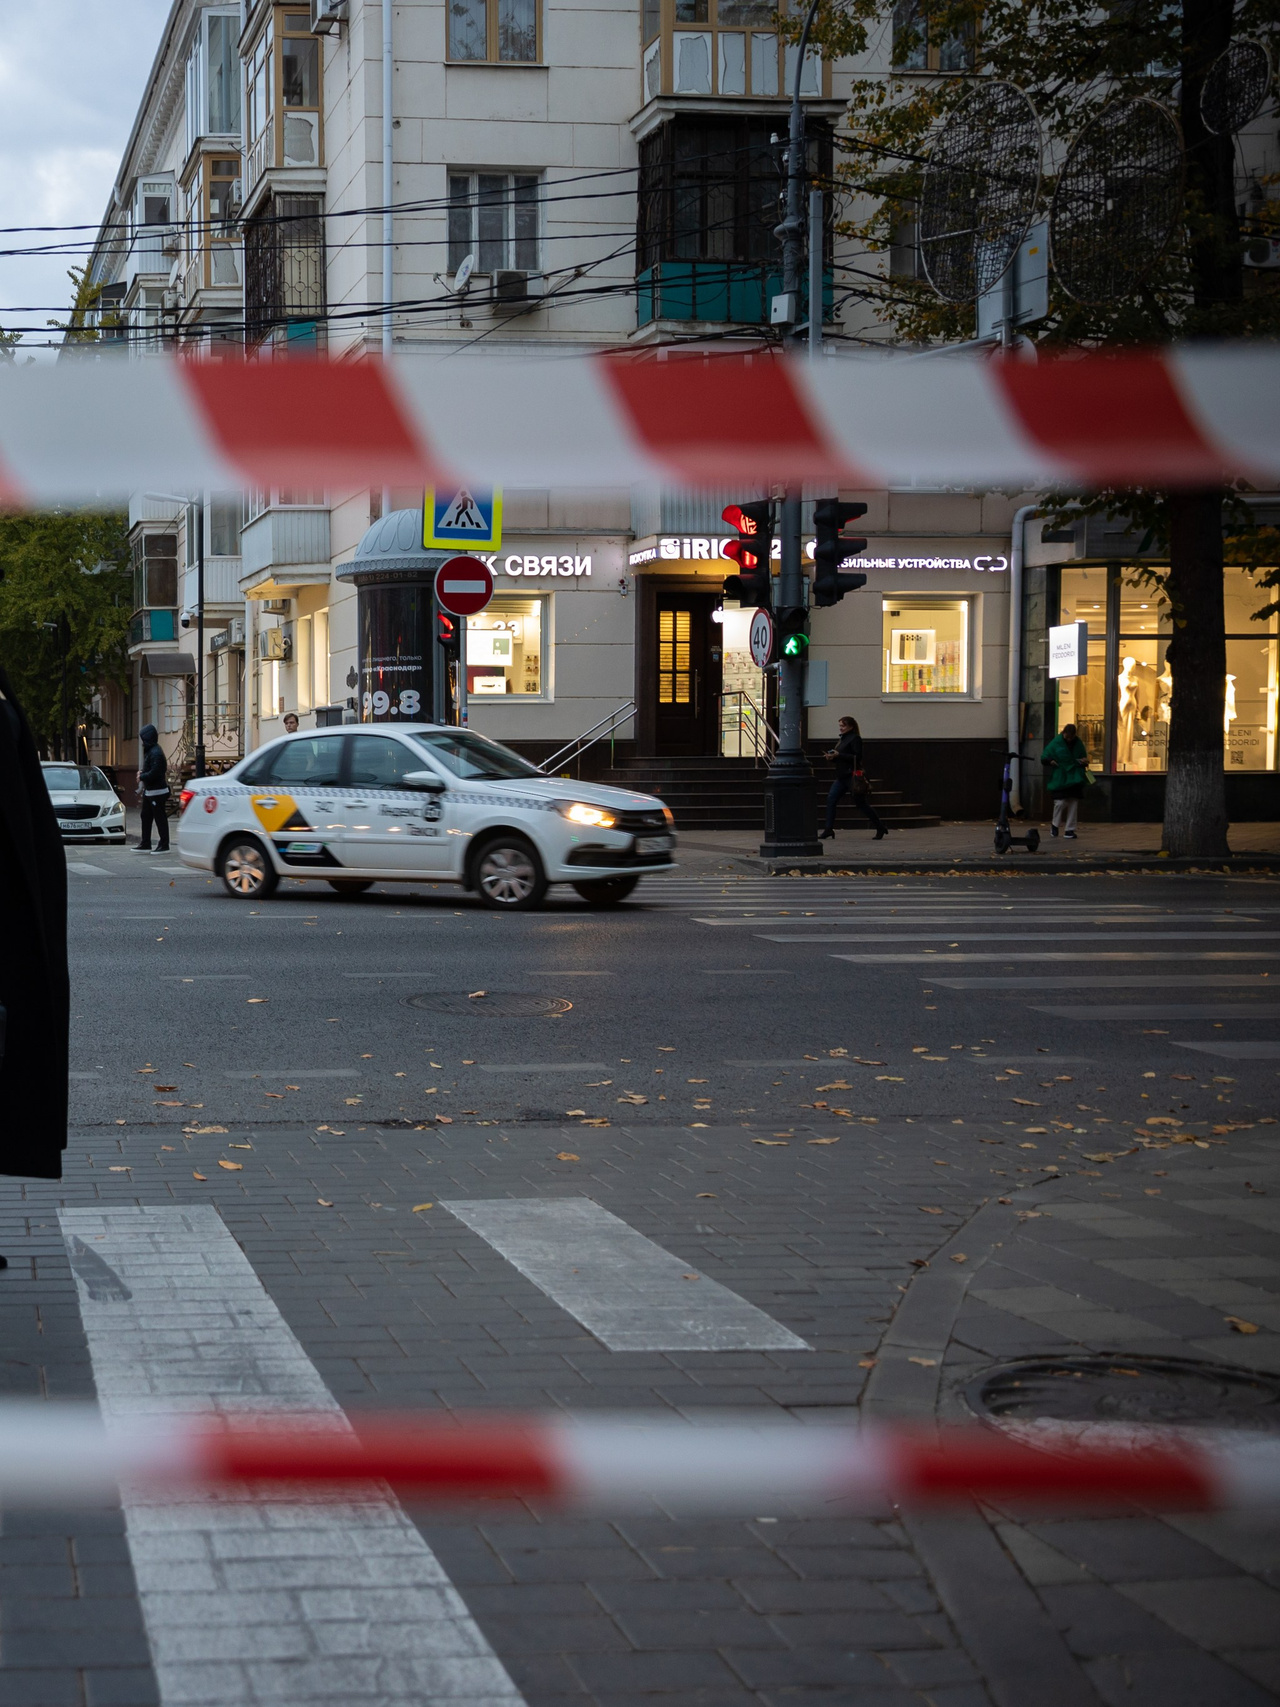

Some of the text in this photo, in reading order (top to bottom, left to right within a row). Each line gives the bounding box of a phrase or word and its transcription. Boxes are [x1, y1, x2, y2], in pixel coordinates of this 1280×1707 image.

[504, 555, 592, 576] СВЯЗИ
[837, 556, 971, 569] БИЛЬНЫЕ УСТРОЙСТВА
[753, 626, 768, 649] 40
[399, 654, 422, 662] только
[362, 690, 421, 715] 99.8
